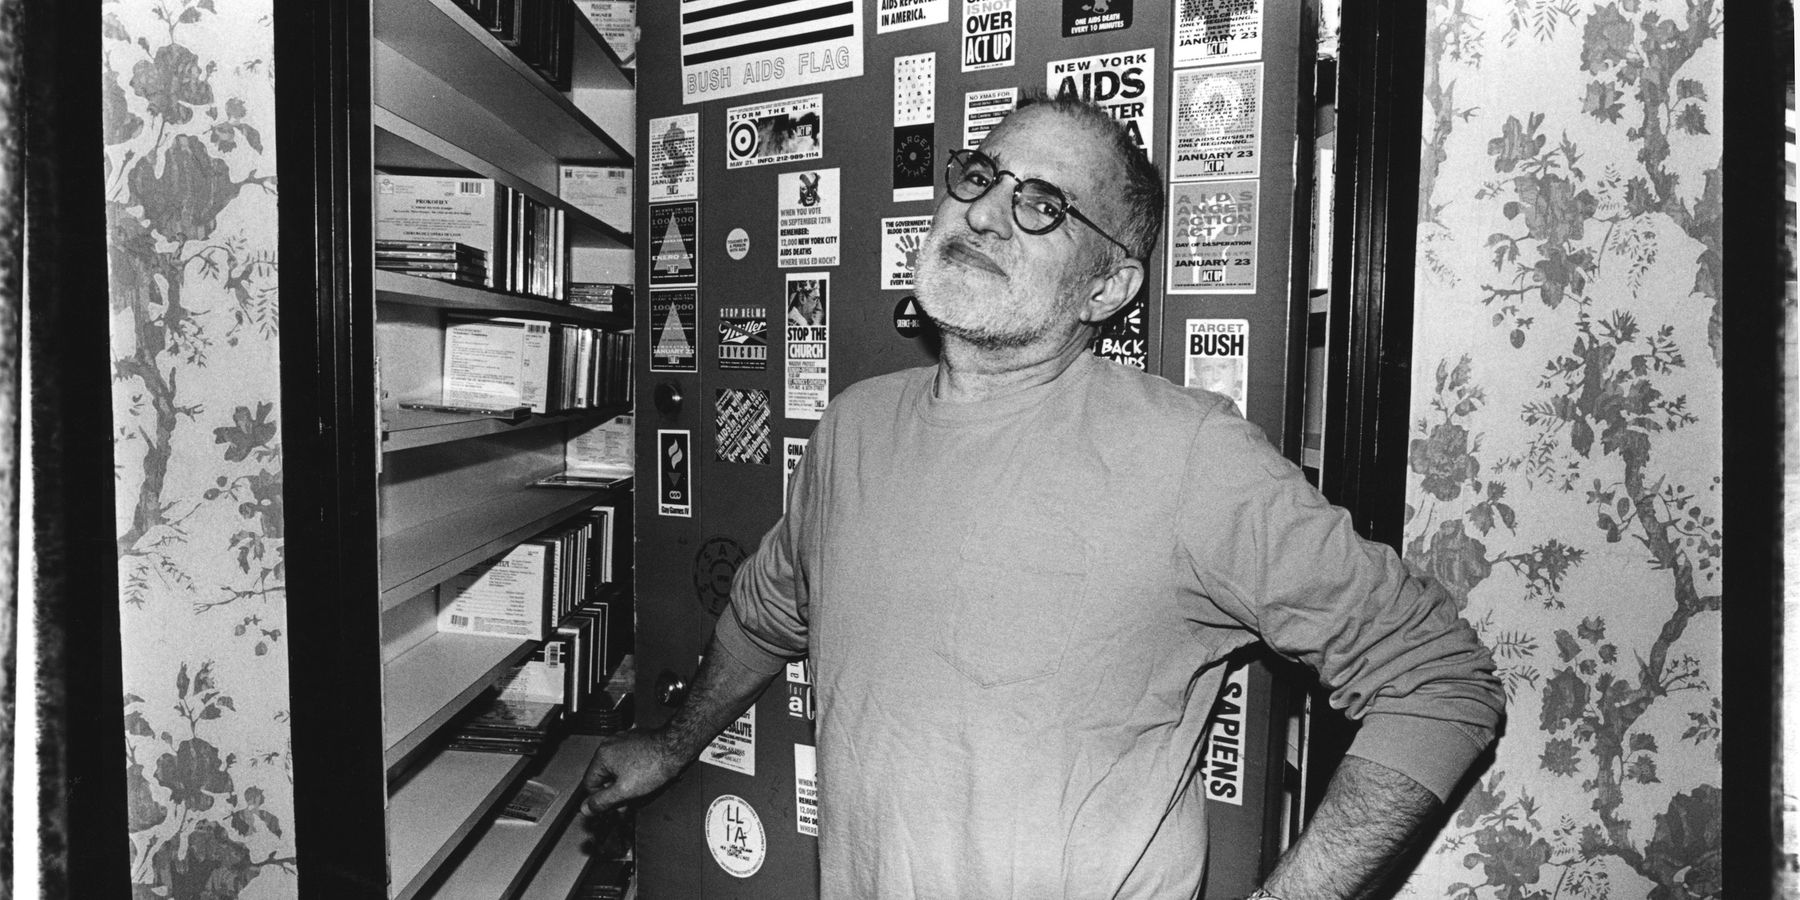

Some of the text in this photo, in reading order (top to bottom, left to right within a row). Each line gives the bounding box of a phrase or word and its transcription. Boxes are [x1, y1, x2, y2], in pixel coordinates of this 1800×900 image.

[967, 1, 1011, 15] IS NOT
[881, 8, 926, 26] IN AMERICA.
[966, 10, 1013, 34] OVER
[1074, 12, 1121, 26] ONE AIDS DEATH
[1197, 13, 1218, 21] AIDS
[1219, 10, 1248, 19] CRISIS
[1071, 20, 1125, 34] EVERY 10 MINUTES
[1179, 31, 1258, 47] JANUARY 23
[966, 32, 1012, 65] ACT UP
[1054, 53, 1147, 74] NEW YORK
[686, 46, 850, 95] BUSH AIDS FLAG
[1056, 67, 1146, 102] AIDS
[730, 111, 762, 121] STORM
[768, 107, 786, 116] THE
[793, 102, 820, 111] N.I.H.
[730, 160, 744, 168] MAY
[757, 156, 774, 164] INFO:
[1177, 150, 1254, 162] JANUARY 23
[1203, 159, 1225, 173] ACT UP
[651, 178, 683, 186] JANUARY
[780, 206, 822, 217] WHEN YOU VOTE
[1177, 202, 1253, 216] ANGER
[780, 216, 832, 227] ON SEPTEMBER 12TH
[895, 219, 927, 227] GOVERNMENT
[1177, 213, 1252, 227] ACTION
[780, 227, 810, 237] REMEMBER:
[1177, 225, 1252, 238] ACT UP
[781, 236, 838, 247] 12,000 NEW YORK CITY
[780, 247, 812, 256] AIDS DEATHS
[780, 256, 837, 266] WHERE WAS ED KOCH?
[1175, 258, 1251, 268] JANUARY 23
[1203, 269, 1223, 283] ACT UP
[720, 307, 767, 319] STOP HELMS
[718, 320, 768, 343] Miller
[787, 326, 827, 342] STOP THE
[1190, 323, 1244, 333] TARGET
[789, 343, 824, 359] CHURCH
[1190, 333, 1245, 356] BUSH
[719, 346, 767, 359] BOYCOTT
[1115, 355, 1146, 370] AIDS
[661, 506, 670, 515] Gay
[670, 506, 684, 516] Games
[1209, 682, 1243, 799] SAPIENS
[798, 778, 814, 787] WHEN
[798, 787, 806, 796] ON
[799, 805, 817, 816] 12,000
[799, 815, 811, 825] AIDS
[799, 824, 817, 835] WHERE
